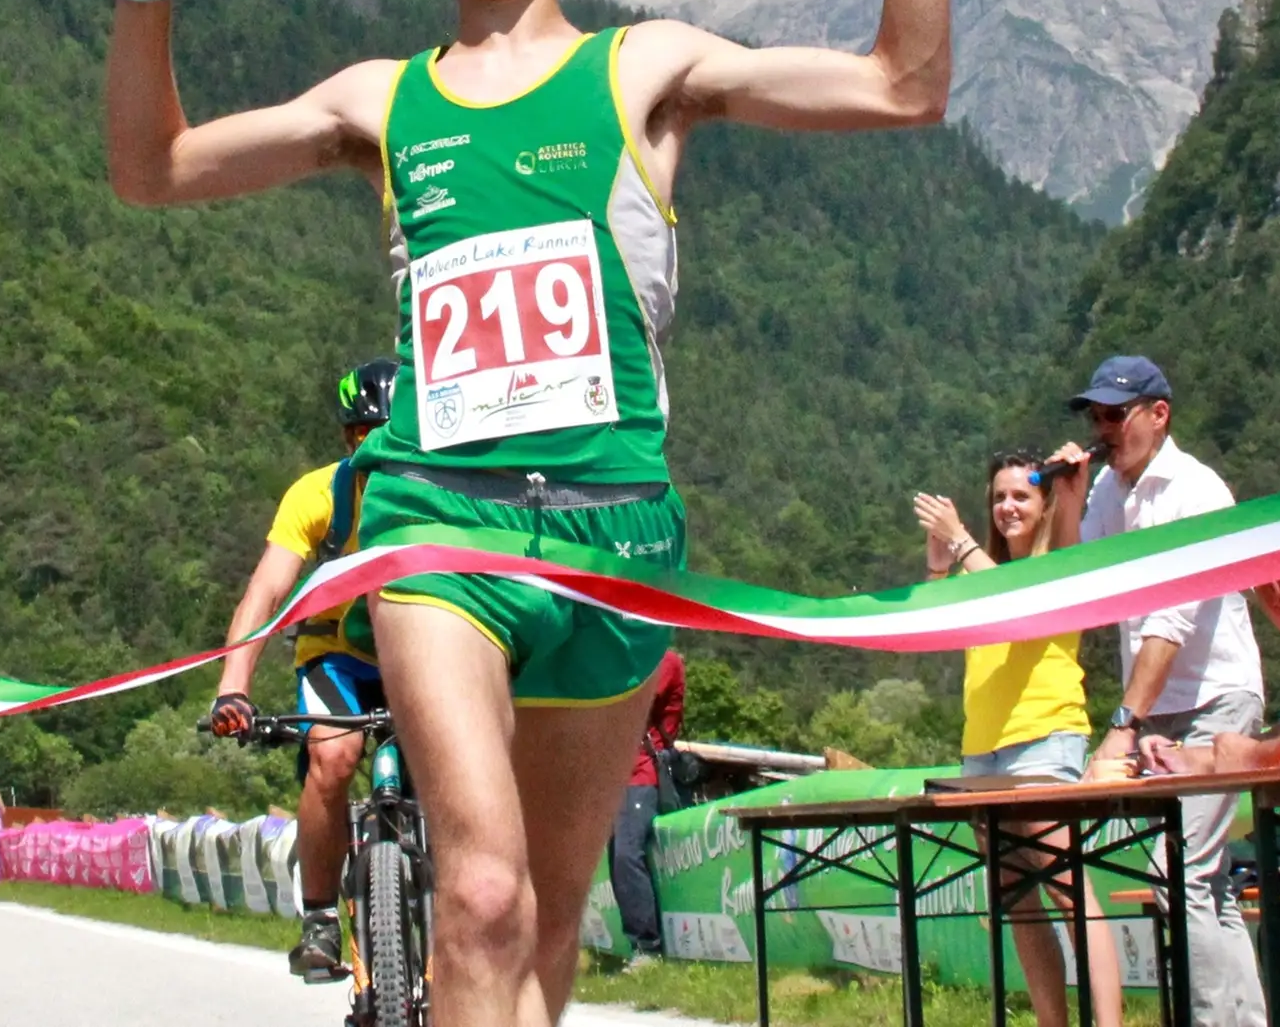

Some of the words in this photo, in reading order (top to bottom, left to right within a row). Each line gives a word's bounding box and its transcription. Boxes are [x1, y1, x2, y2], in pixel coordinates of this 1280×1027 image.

[538, 142, 586, 155] ATLETICA
[415, 254, 468, 284] Molveno
[473, 243, 516, 262] Lake
[424, 261, 590, 380] 219
